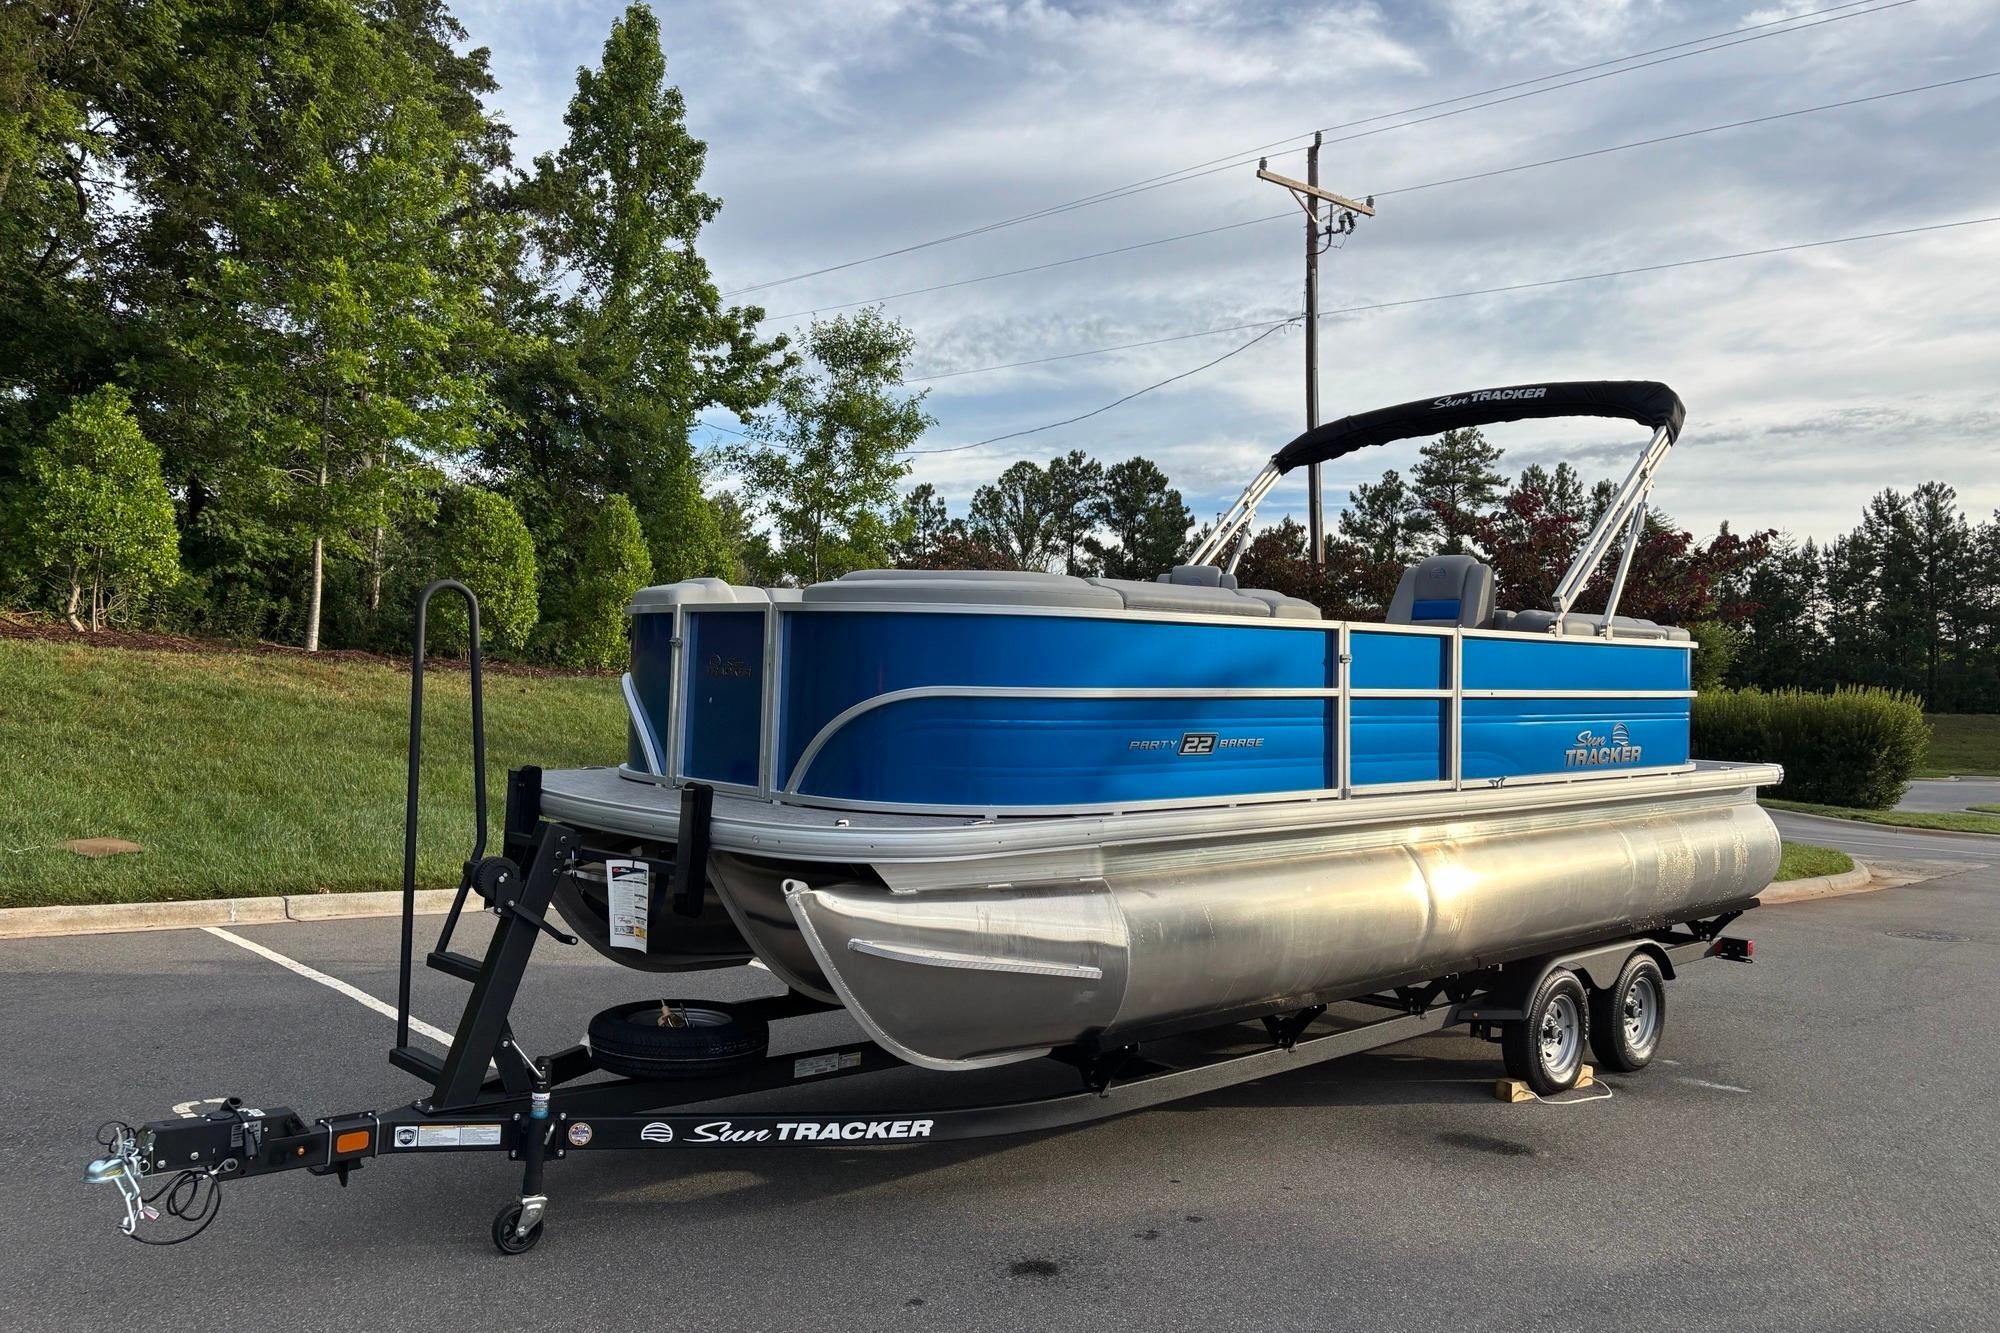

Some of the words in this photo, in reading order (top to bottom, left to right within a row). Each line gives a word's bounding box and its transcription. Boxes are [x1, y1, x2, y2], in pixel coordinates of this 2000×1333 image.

[1429, 396, 1469, 410] Sun
[1471, 388, 1547, 403] TRACKER
[1128, 739, 1178, 750] PARTY
[1182, 737, 1213, 753] 22
[1218, 737, 1265, 749] BARGE
[1572, 730, 1607, 747] Sun
[1565, 745, 1642, 769] TRACKER
[682, 1121, 772, 1142] Sun
[776, 1119, 934, 1141] TRACKER
